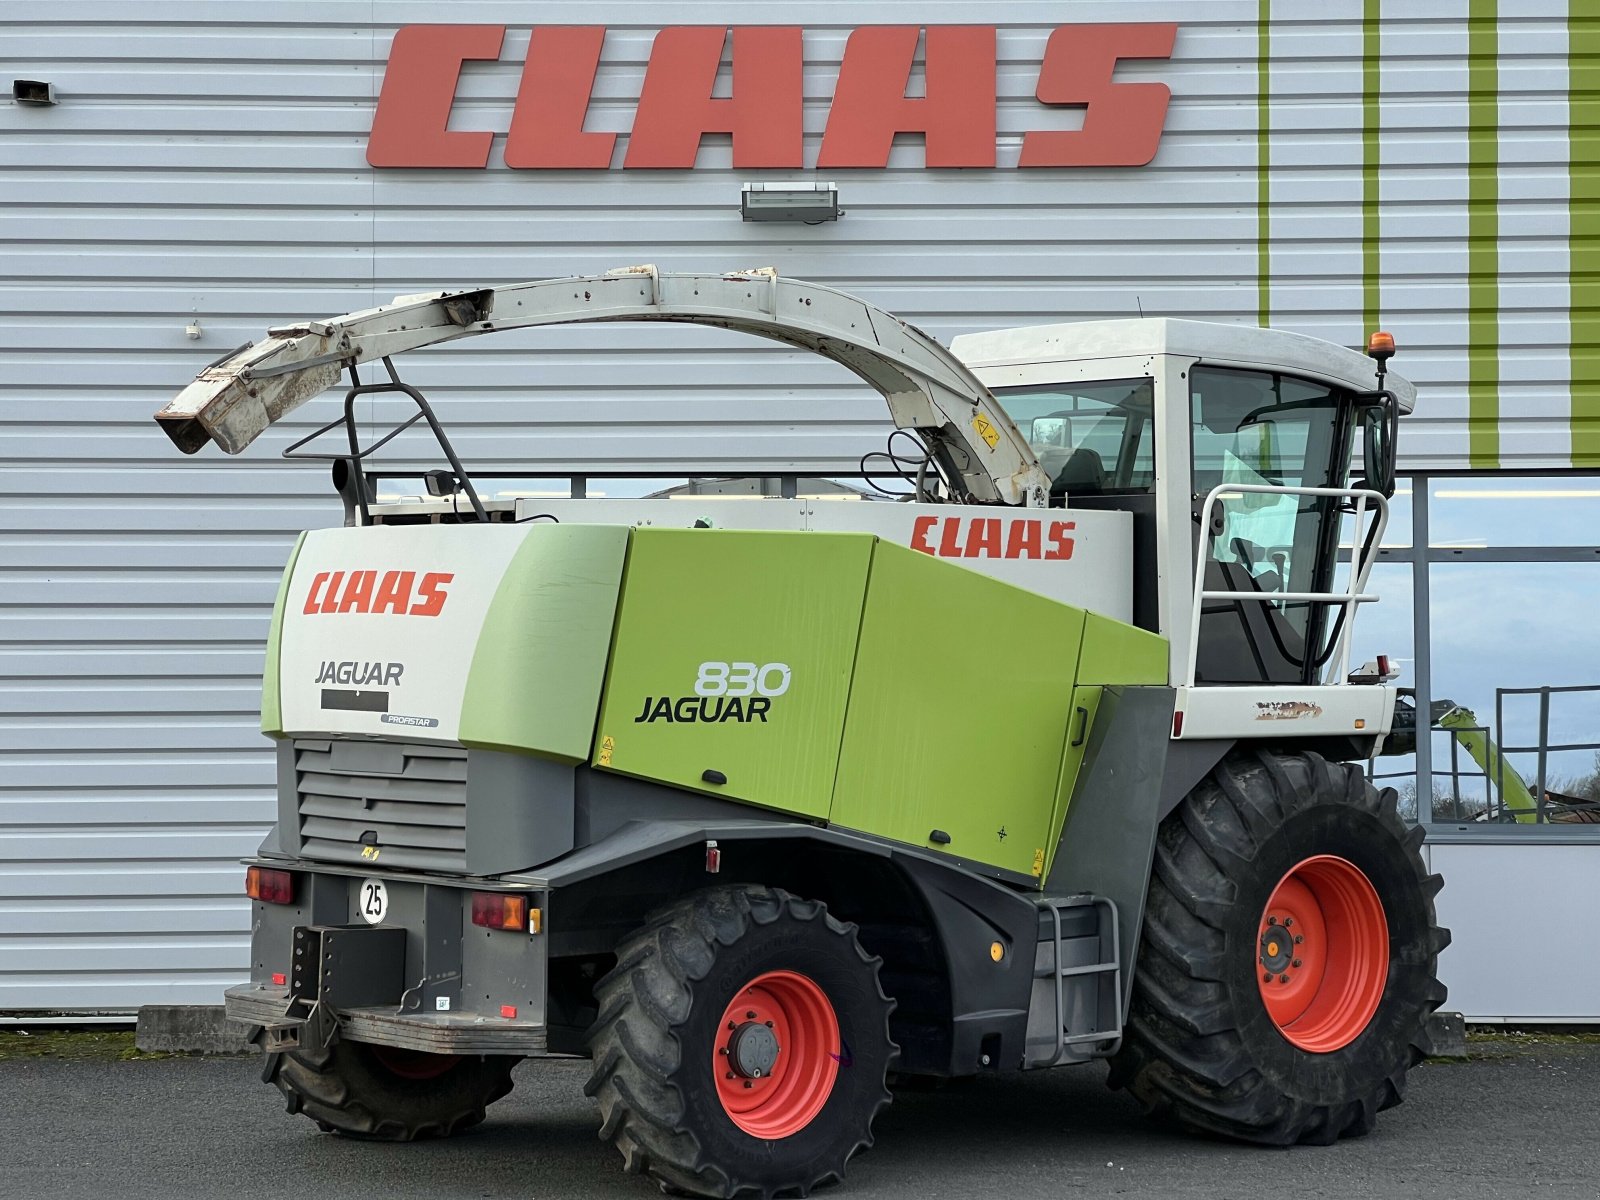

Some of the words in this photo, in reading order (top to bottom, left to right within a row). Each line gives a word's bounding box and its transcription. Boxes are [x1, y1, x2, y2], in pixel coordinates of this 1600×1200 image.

[367, 23, 1178, 168] CLAAS
[910, 516, 1076, 560] CLAAS
[303, 570, 454, 617] CLAAS
[314, 661, 404, 686] JAGUAR
[694, 661, 792, 697] 830
[387, 714, 431, 727] PROFISTAR
[634, 696, 771, 723] JAGUAR
[366, 884, 382, 916] 25
